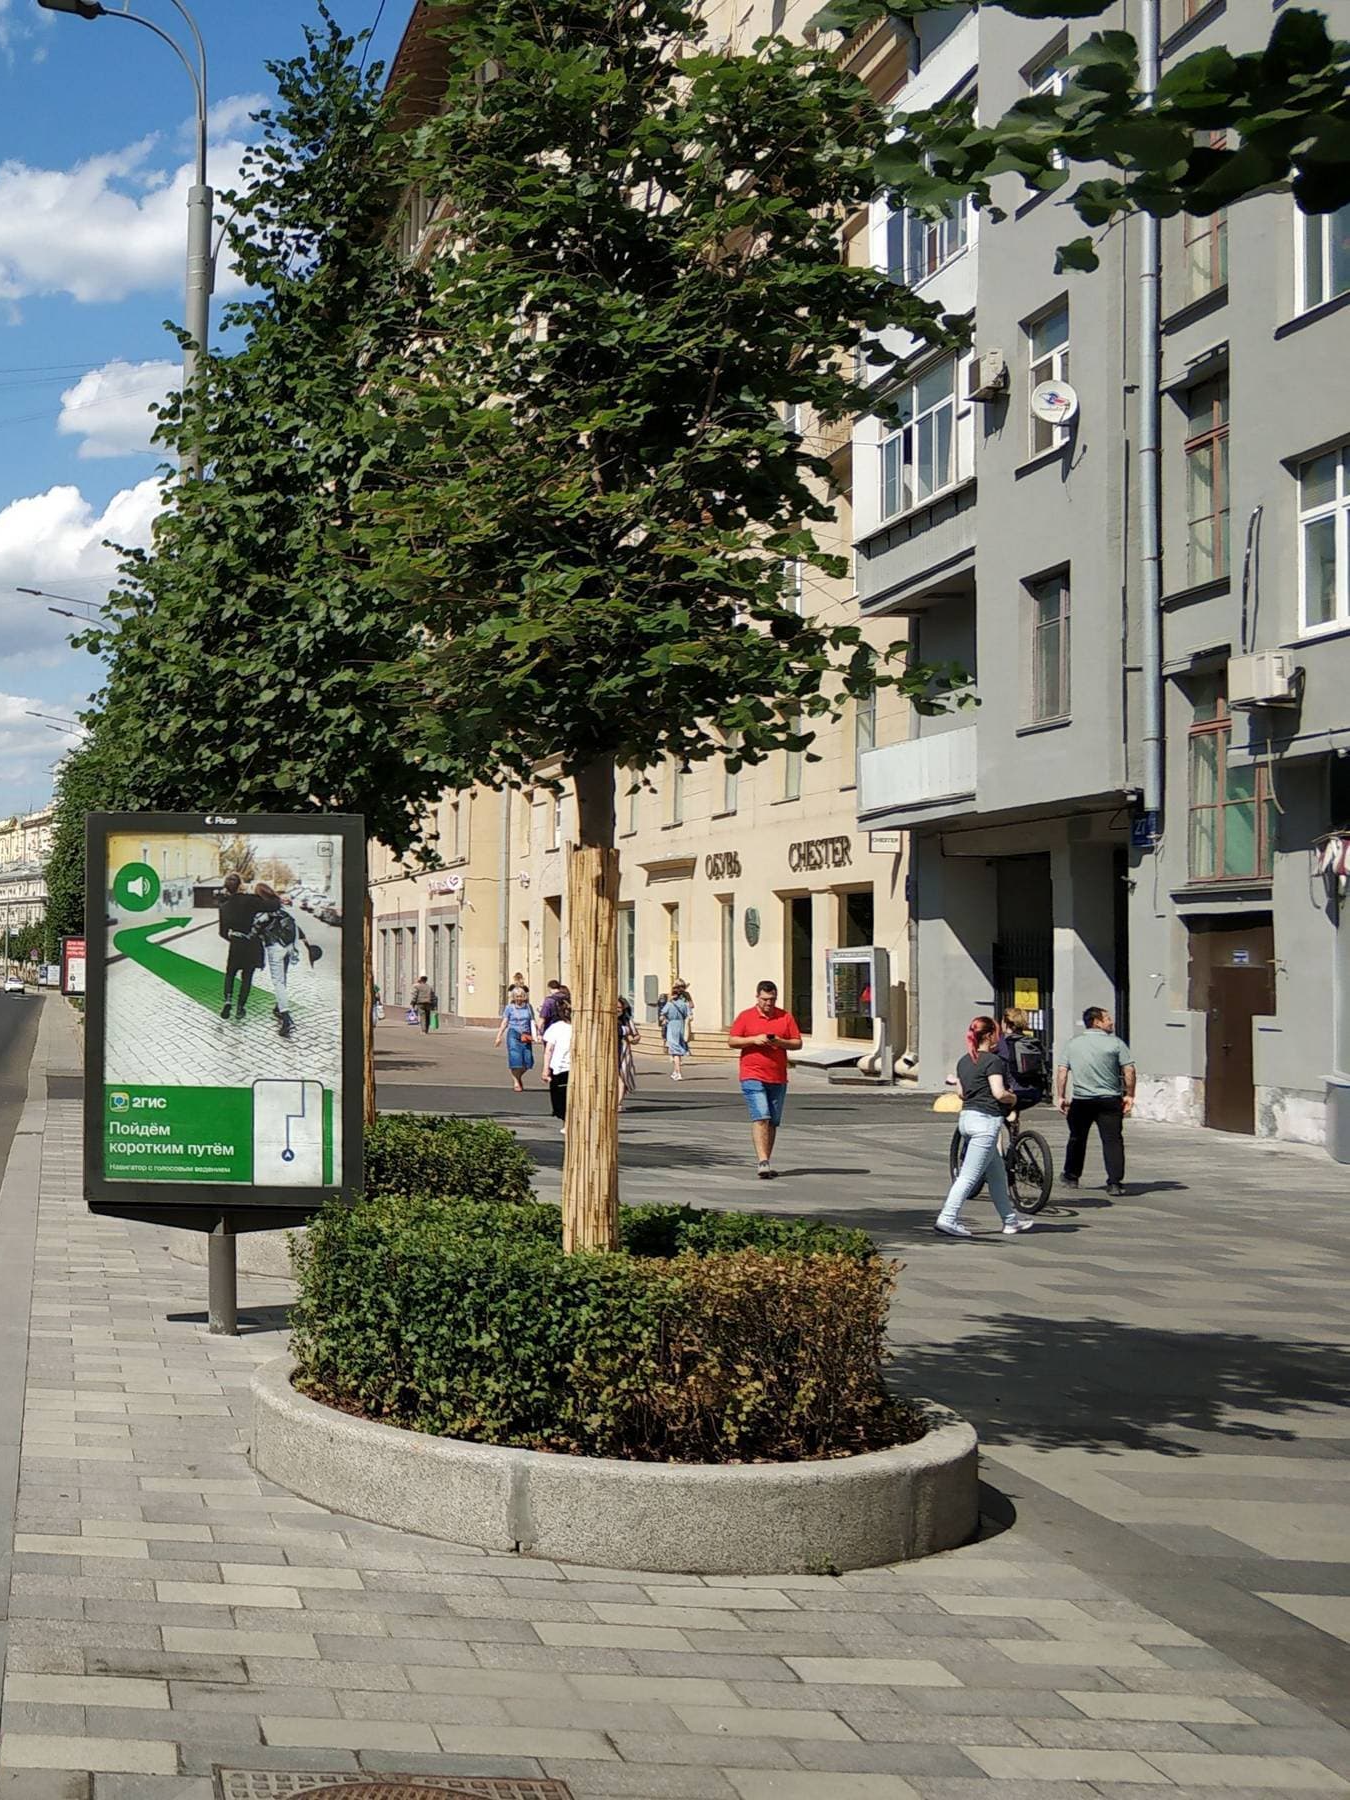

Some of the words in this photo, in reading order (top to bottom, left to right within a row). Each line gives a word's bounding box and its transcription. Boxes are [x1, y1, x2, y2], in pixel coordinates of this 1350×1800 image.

[214, 815, 238, 825] Russ
[788, 835, 852, 871] CHESTER
[705, 851, 742, 879] ОБУВЬ
[132, 1097, 167, 1109] 2ГИС
[109, 1121, 170, 1137] Пойдём
[109, 1142, 184, 1155] коротким
[187, 1143, 235, 1157] путём
